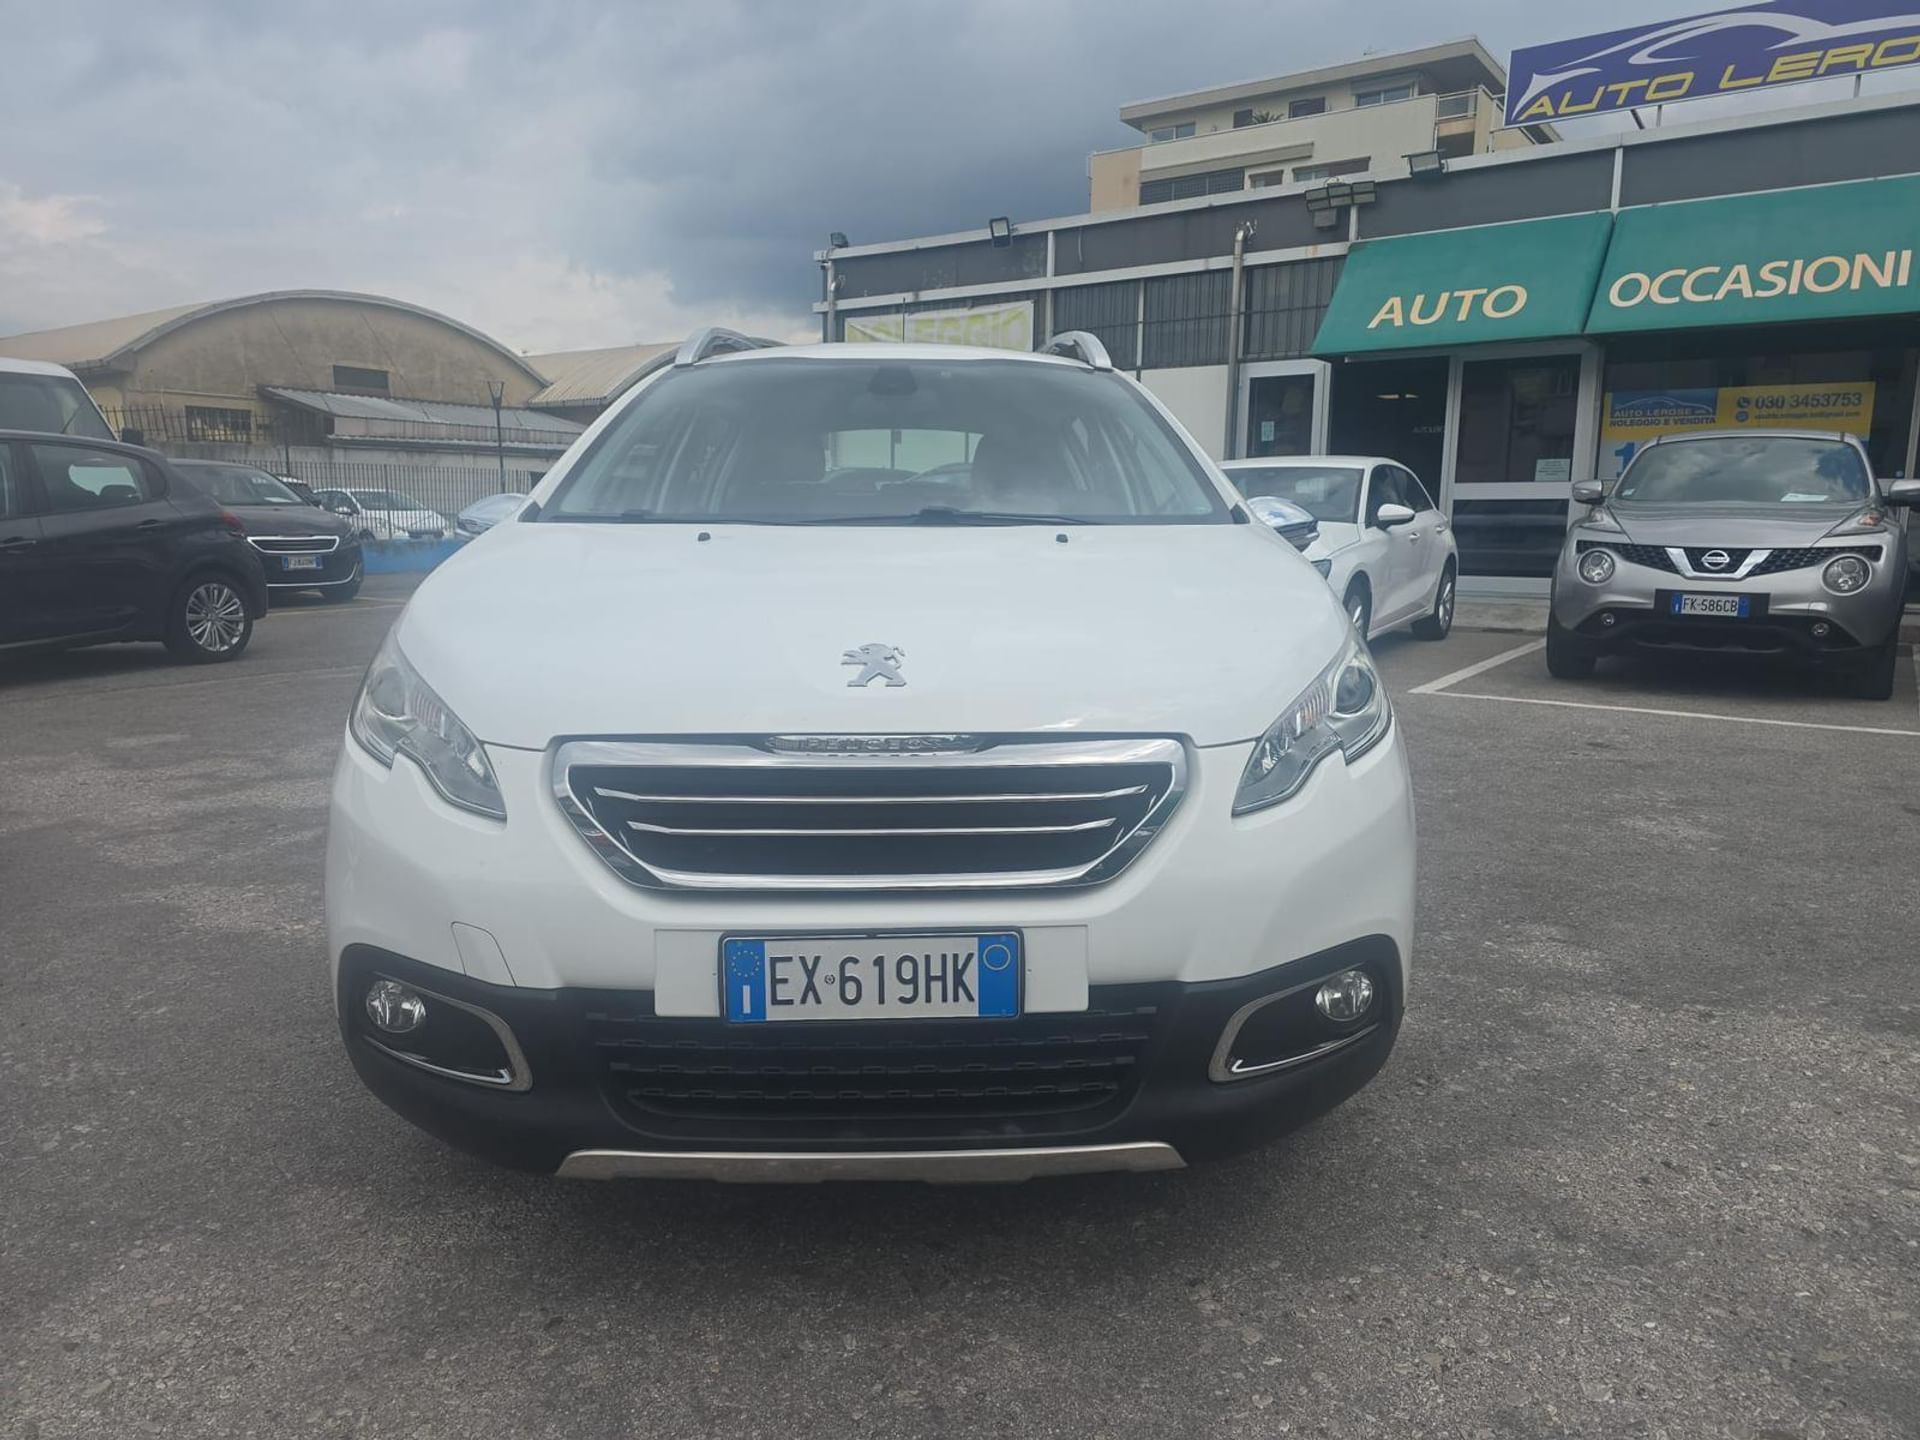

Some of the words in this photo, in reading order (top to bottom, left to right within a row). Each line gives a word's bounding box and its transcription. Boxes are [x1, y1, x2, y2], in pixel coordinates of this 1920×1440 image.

[1518, 71, 1695, 121] AUTO
[1366, 284, 1528, 330] AUTO
[1608, 248, 1913, 308] OCCASIONI
[1614, 408, 1643, 418] AUTO
[1754, 395, 1785, 410] 030
[1792, 392, 1863, 409] 3453753
